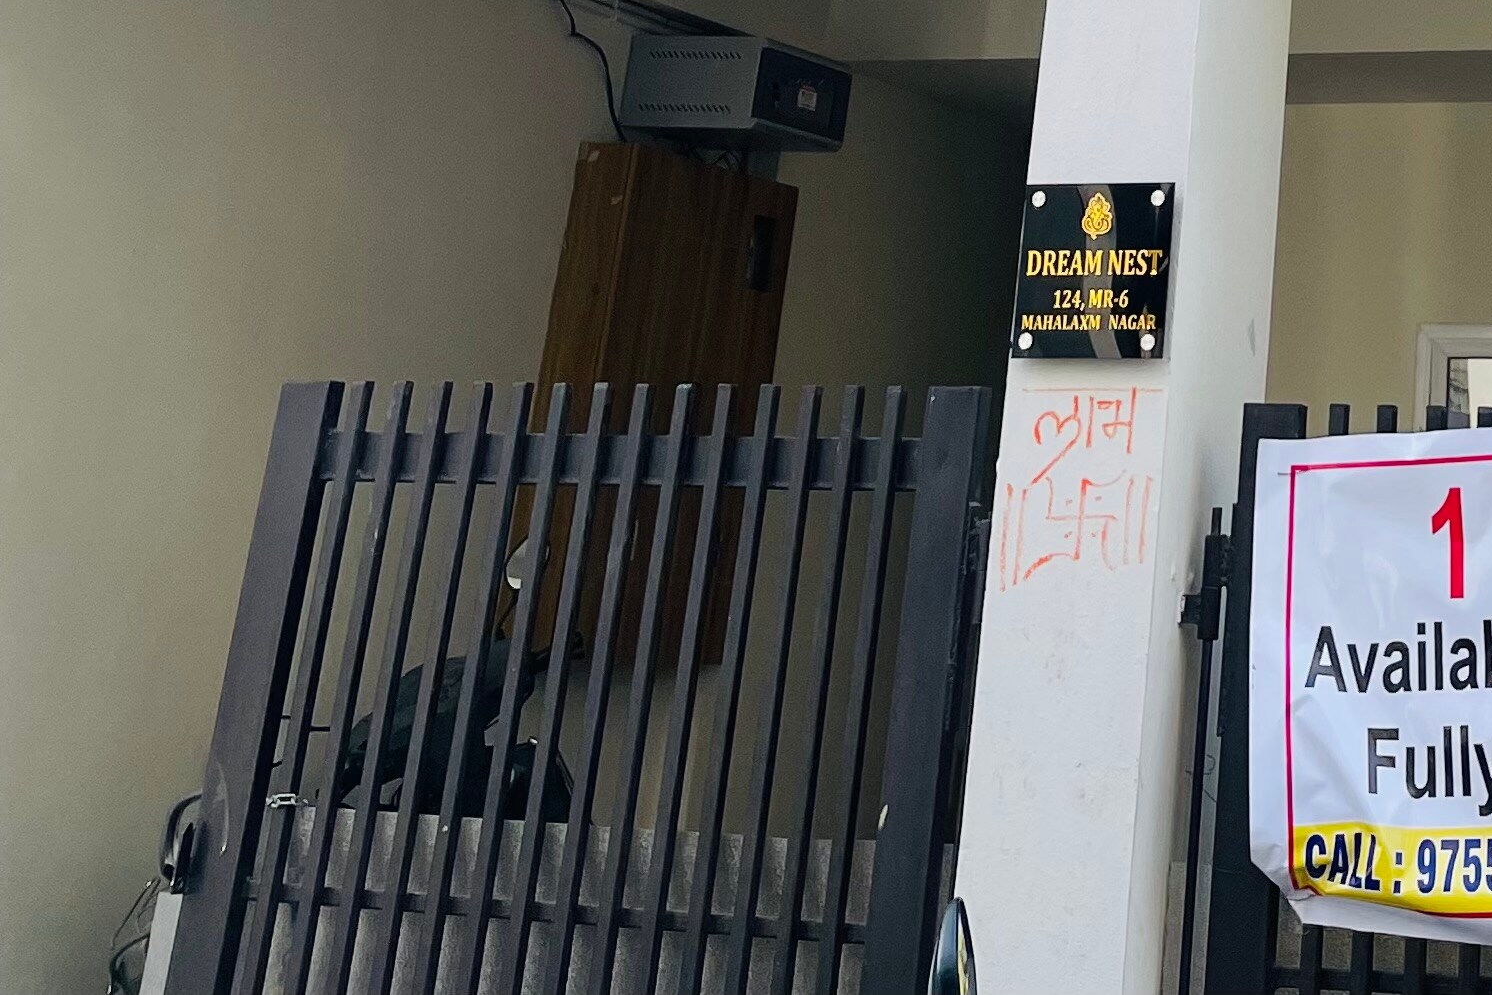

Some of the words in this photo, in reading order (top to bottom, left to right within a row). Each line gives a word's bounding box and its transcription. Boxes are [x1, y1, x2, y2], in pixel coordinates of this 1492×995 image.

[1026, 249, 1102, 277] DREAM
[1107, 249, 1163, 276] NEST
[1053, 289, 1085, 312] 124,
[1088, 289, 1129, 309] MR-6
[1108, 314, 1157, 331] NAGAR
[1431, 486, 1465, 600] 1
[1304, 831, 1382, 893] CALL
